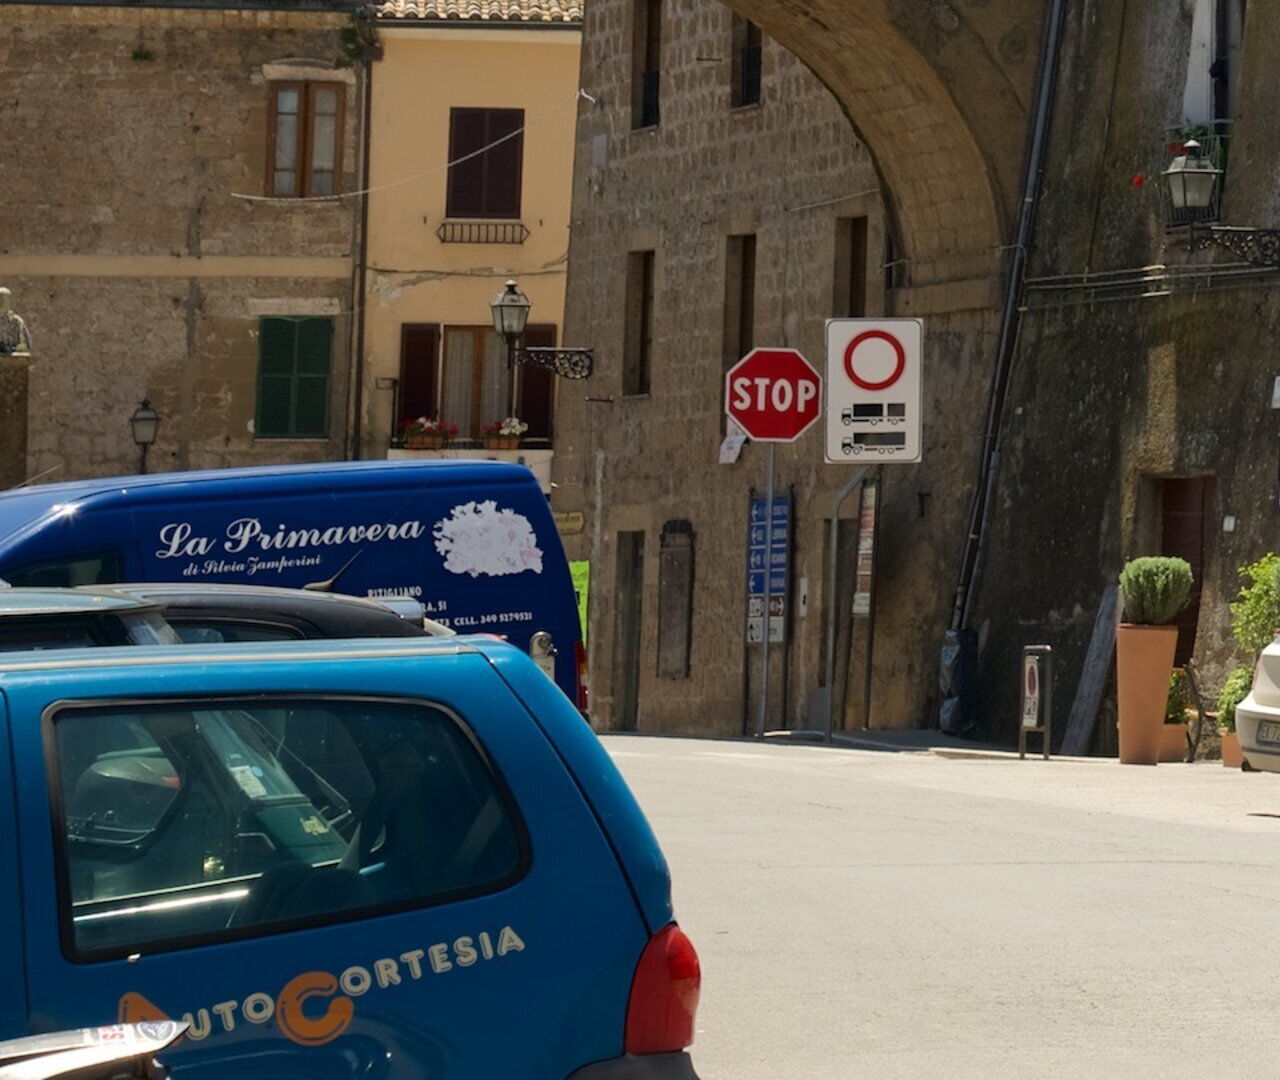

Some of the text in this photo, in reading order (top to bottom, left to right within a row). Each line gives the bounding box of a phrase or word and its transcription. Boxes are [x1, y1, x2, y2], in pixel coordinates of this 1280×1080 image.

[732, 377, 817, 413] STOP
[155, 517, 425, 559] La Primavera
[183, 563, 198, 576] di
[367, 586, 422, 598] PITIGLIANO
